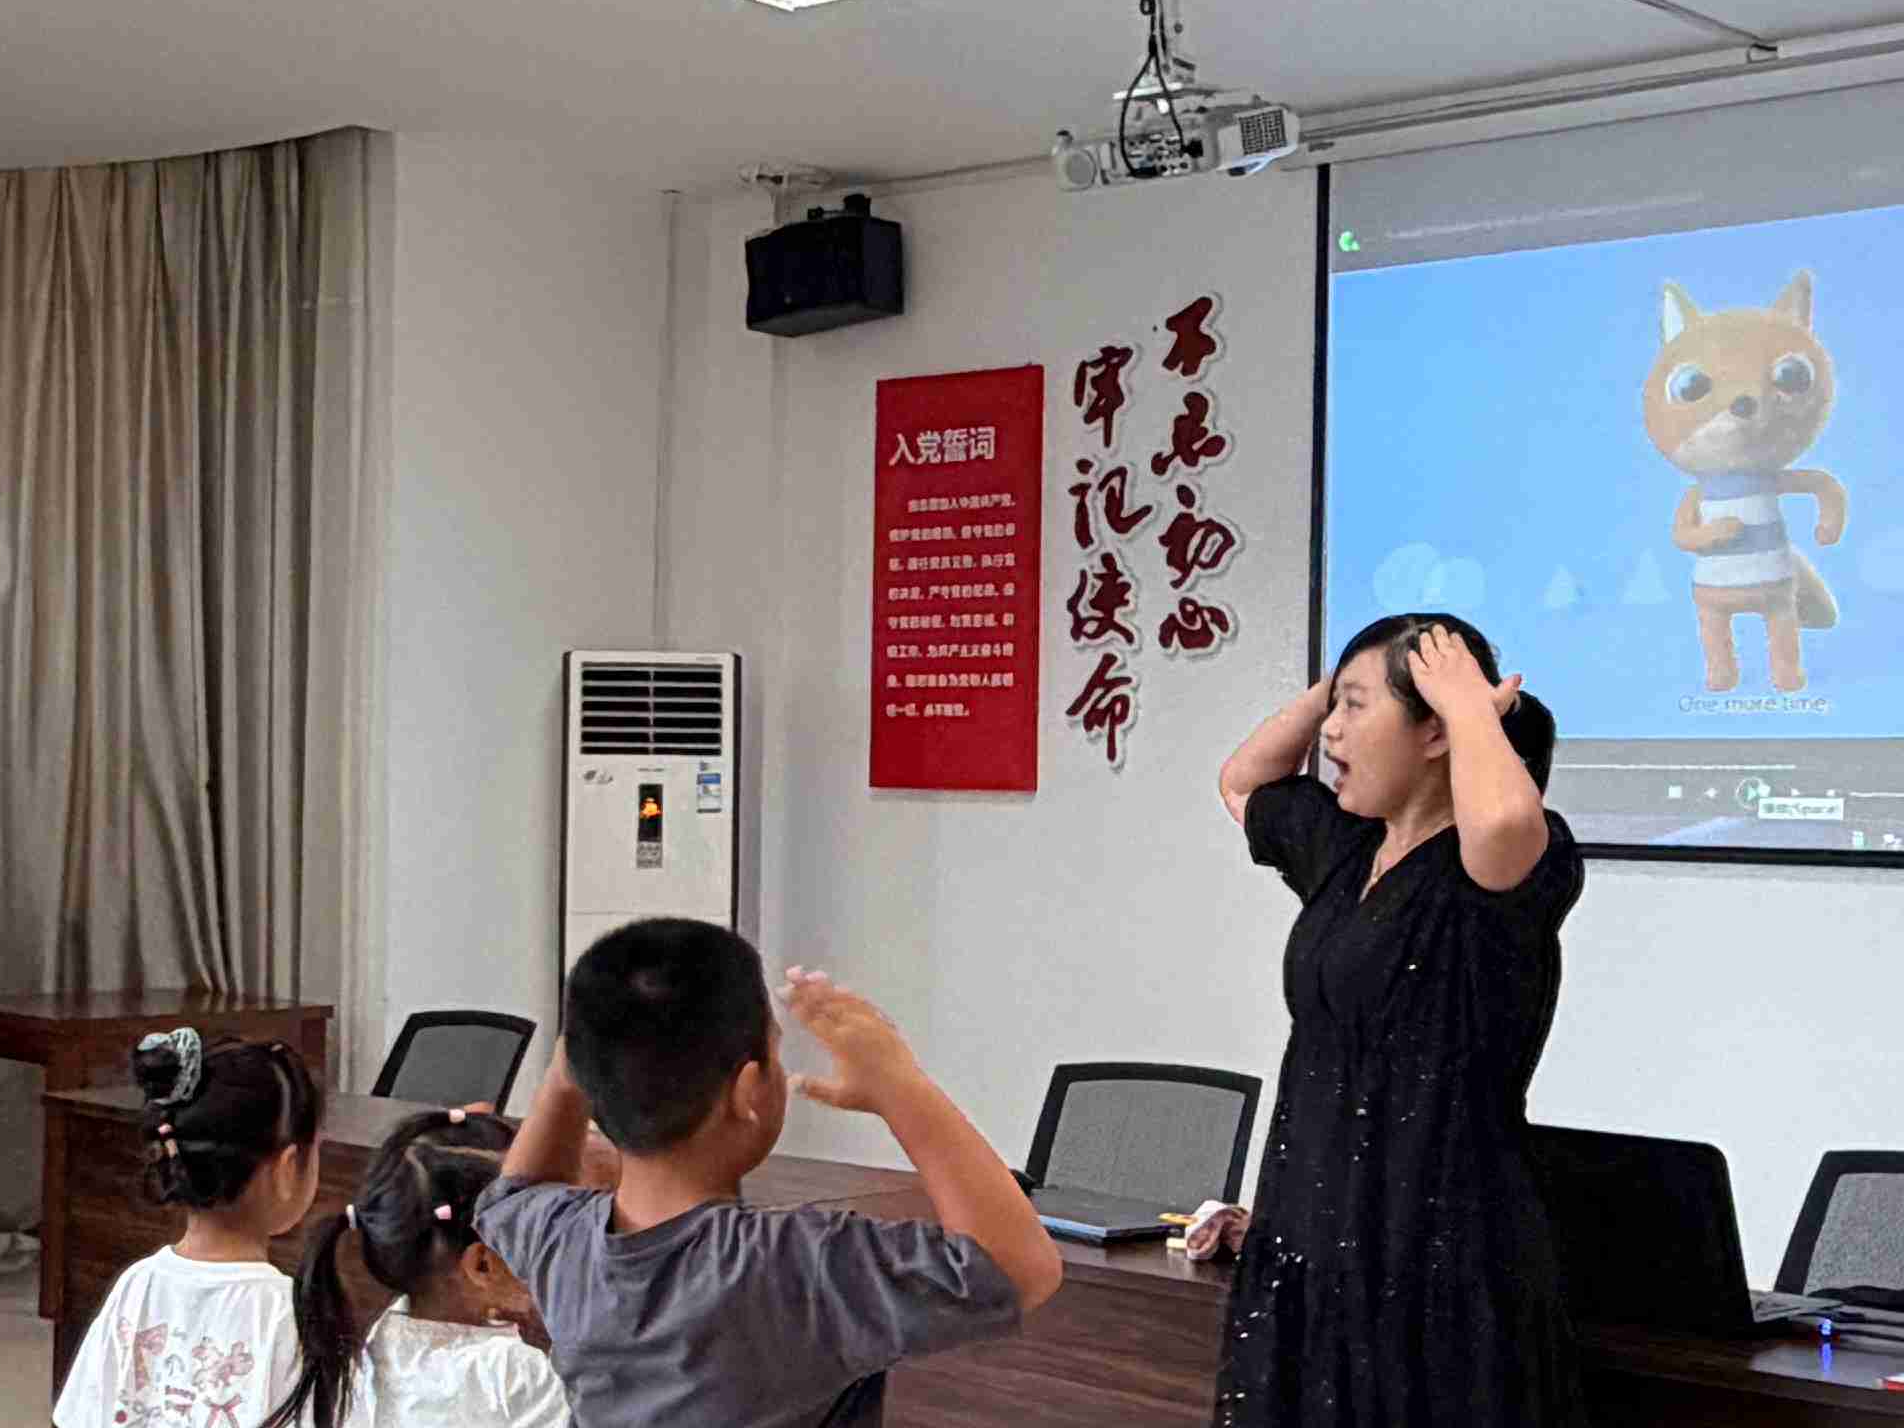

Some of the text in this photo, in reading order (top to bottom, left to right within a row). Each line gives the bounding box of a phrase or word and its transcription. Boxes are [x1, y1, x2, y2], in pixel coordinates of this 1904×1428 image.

[889, 426, 996, 467] 入党誓词
[1066, 345, 1153, 762] 牢记使命
[1150, 296, 1235, 650] 不忘初心
